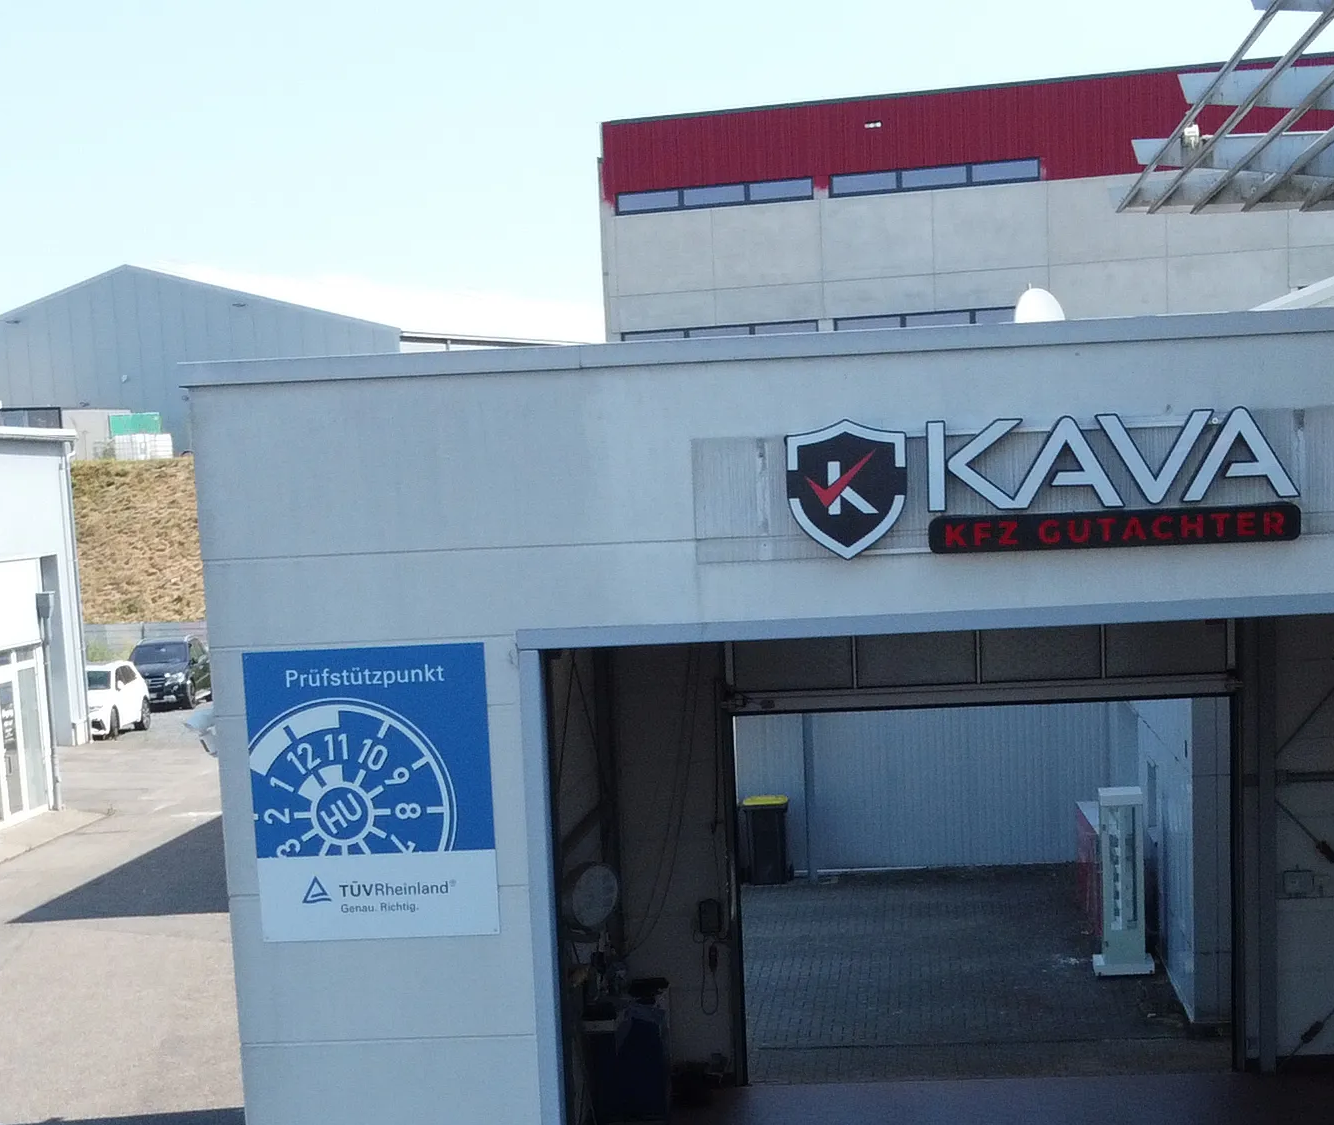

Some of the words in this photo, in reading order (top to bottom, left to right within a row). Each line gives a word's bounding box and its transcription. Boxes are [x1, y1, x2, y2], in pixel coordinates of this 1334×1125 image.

[925, 406, 1301, 513] KAVA
[943, 520, 1020, 549] KFZ
[1037, 511, 1286, 545] GUTACHTER
[285, 664, 446, 689] Prüfstützpunkt
[263, 807, 291, 825] 2
[286, 742, 322, 775] 12
[324, 733, 349, 761] 11
[357, 738, 389, 771] 10
[395, 802, 422, 820] 8
[319, 793, 363, 834] HU
[340, 904, 378, 914] Genau.
[380, 902, 420, 914] Richtig.
